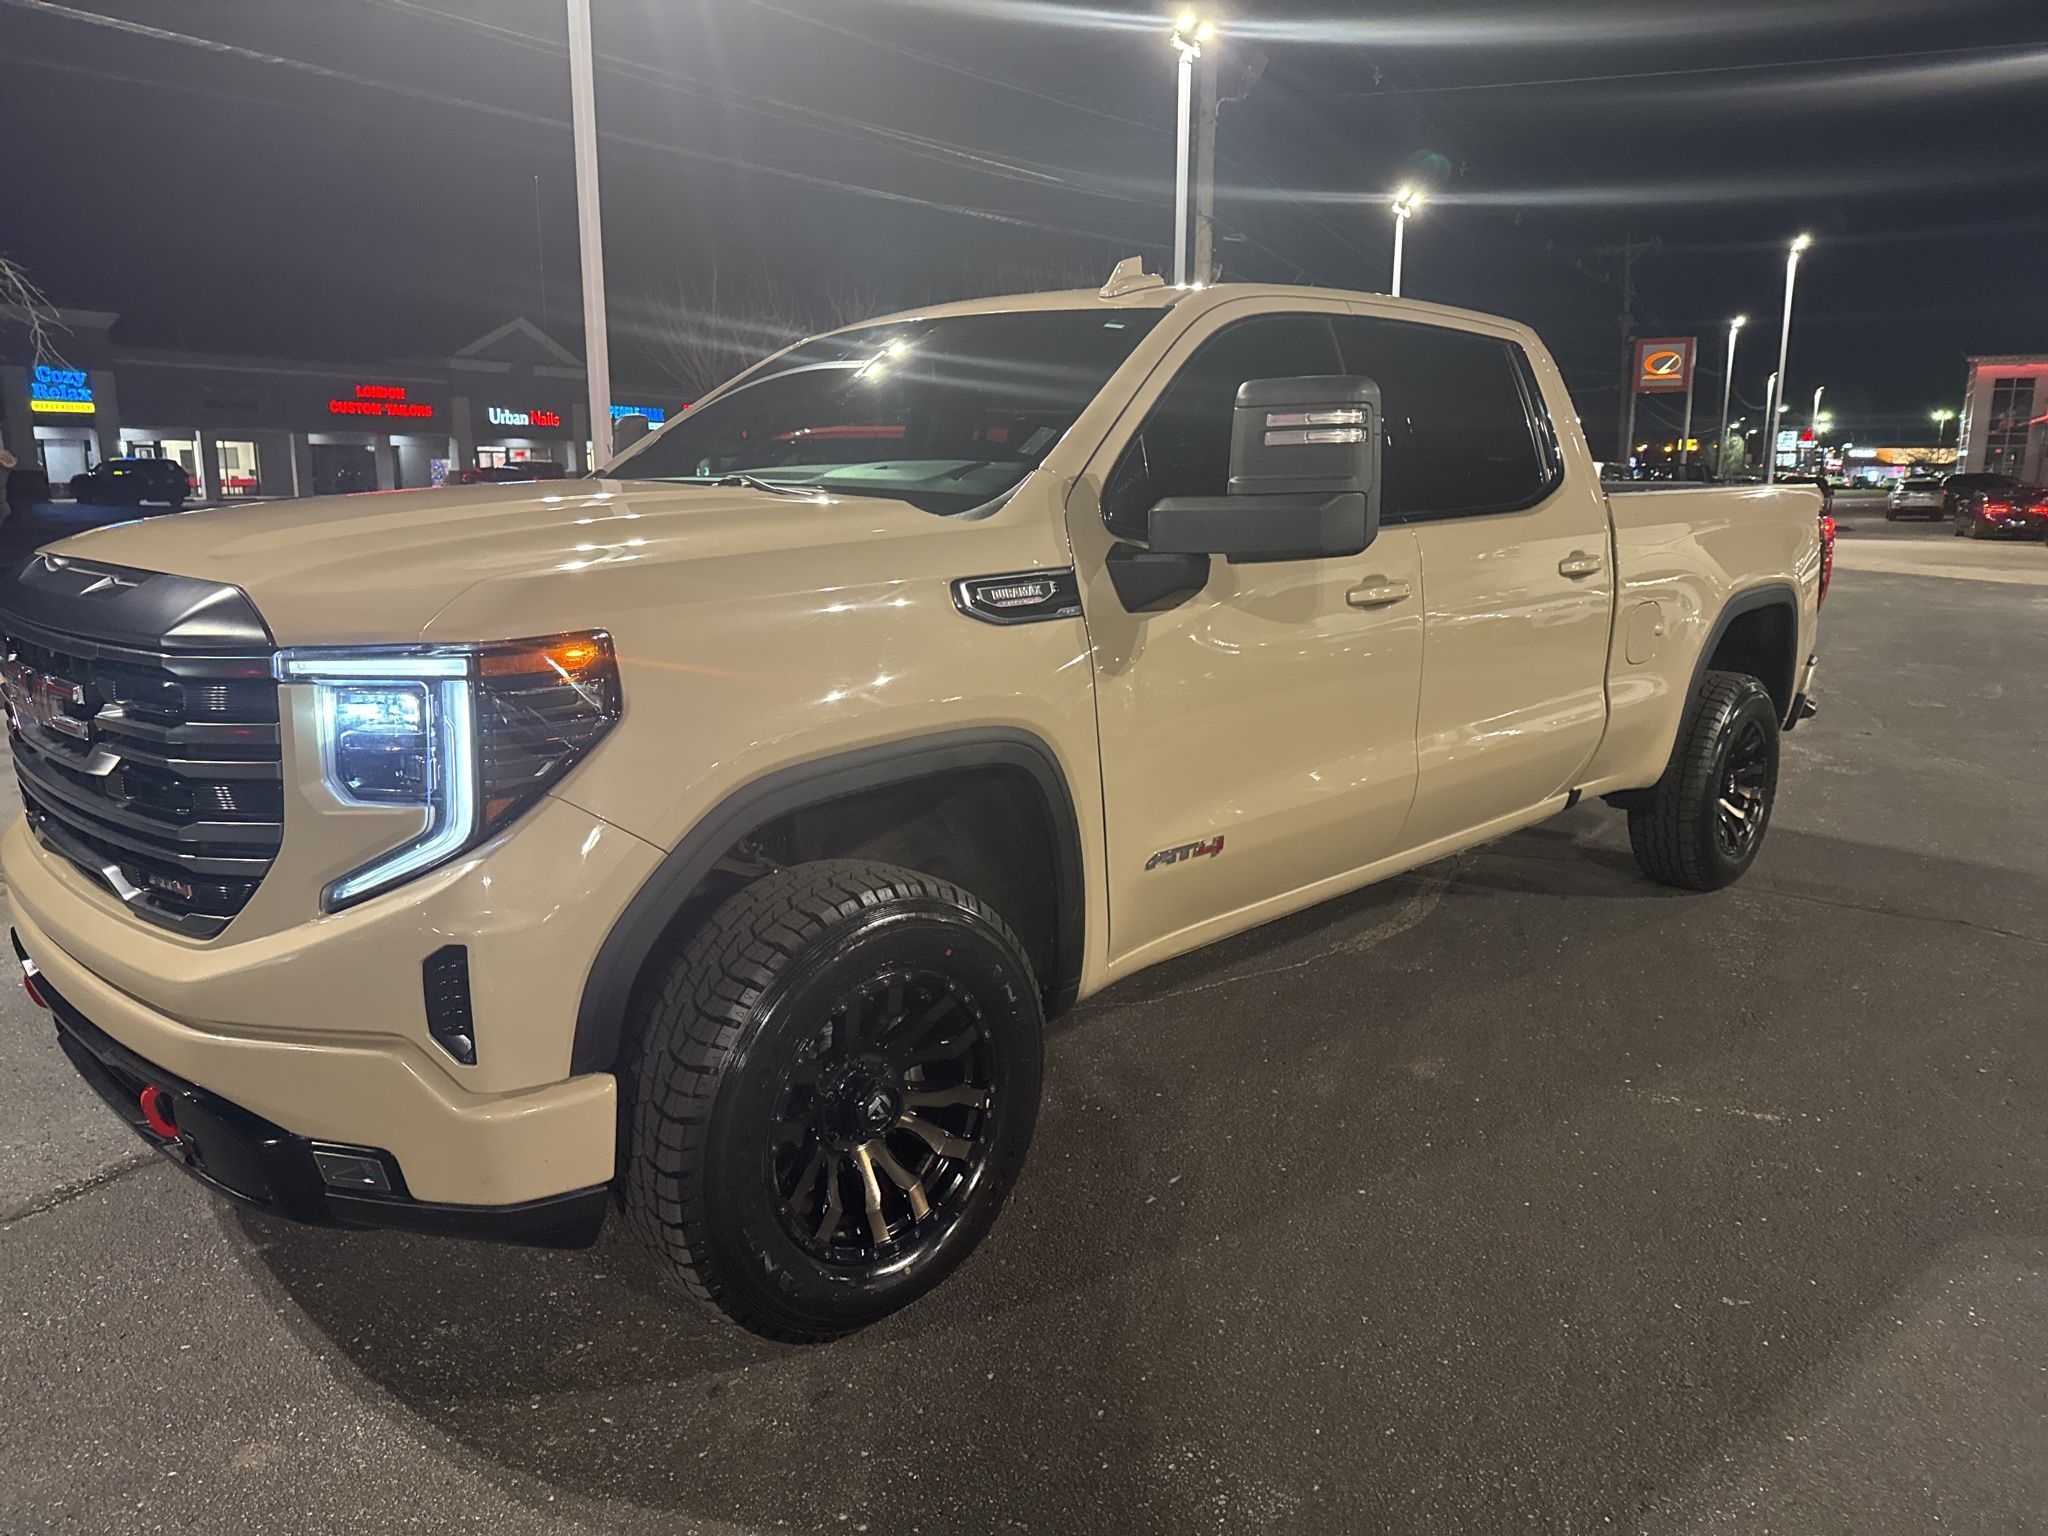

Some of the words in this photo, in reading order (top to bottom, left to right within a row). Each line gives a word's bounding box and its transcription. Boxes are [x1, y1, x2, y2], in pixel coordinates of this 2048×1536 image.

[35, 365, 87, 387] Cozy
[31, 383, 93, 402] Relax
[355, 384, 406, 400] LONDON
[328, 400, 382, 415] CUSTOM
[385, 403, 433, 417] TAILORS
[488, 407, 529, 426] Urban
[530, 410, 560, 427] Nails
